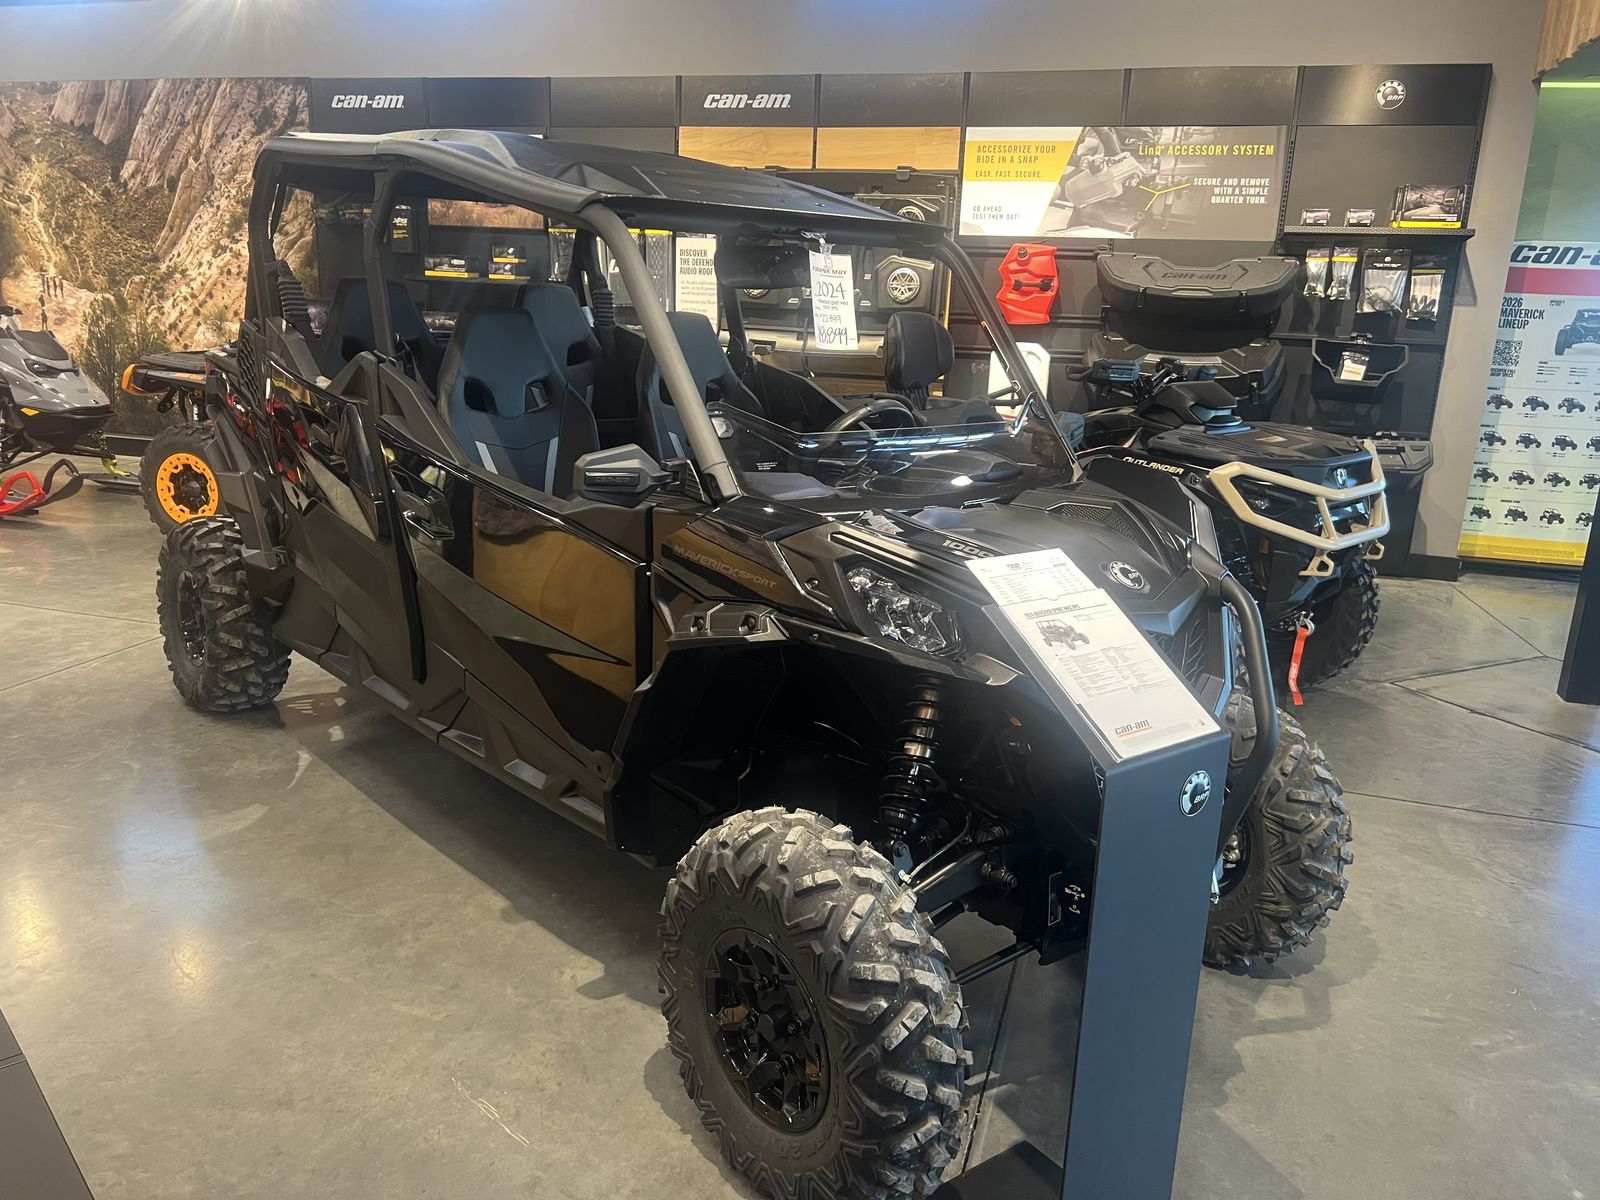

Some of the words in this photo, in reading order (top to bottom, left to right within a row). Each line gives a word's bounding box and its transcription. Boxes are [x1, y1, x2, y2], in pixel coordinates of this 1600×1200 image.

[331, 94, 405, 108] can-am
[703, 93, 791, 108] can-am
[976, 145, 1031, 154] ACCESSORIZE
[1035, 145, 1056, 153] YOUR
[1167, 145, 1229, 155] ACCESSORY
[1232, 145, 1275, 155] SYSTEM
[976, 156, 995, 164] RIDE
[998, 156, 1007, 164] IN
[1009, 156, 1015, 164] A
[1017, 156, 1039, 164] SNAP
[1193, 178, 1221, 186] SECURE
[1223, 178, 1239, 186] AND
[1240, 178, 1270, 186] REMOVE
[1214, 187, 1232, 195] WITH
[1242, 187, 1269, 195] SIMPLE
[1211, 196, 1244, 204] QUARTER
[1246, 196, 1267, 204] TURN.
[679, 249, 708, 257] DISCOVER
[680, 258, 690, 266] THE
[692, 258, 714, 267] DEFEND
[679, 267, 697, 275] AUDIO
[699, 268, 714, 276] ROOF
[814, 281, 847, 300] 2024
[1501, 297, 1524, 308] 2026
[1500, 307, 1546, 320] MAVERICK
[1498, 318, 1529, 330] LINEUP
[1122, 456, 1184, 475] OUTLANDER
[1114, 719, 1150, 735] can-am
